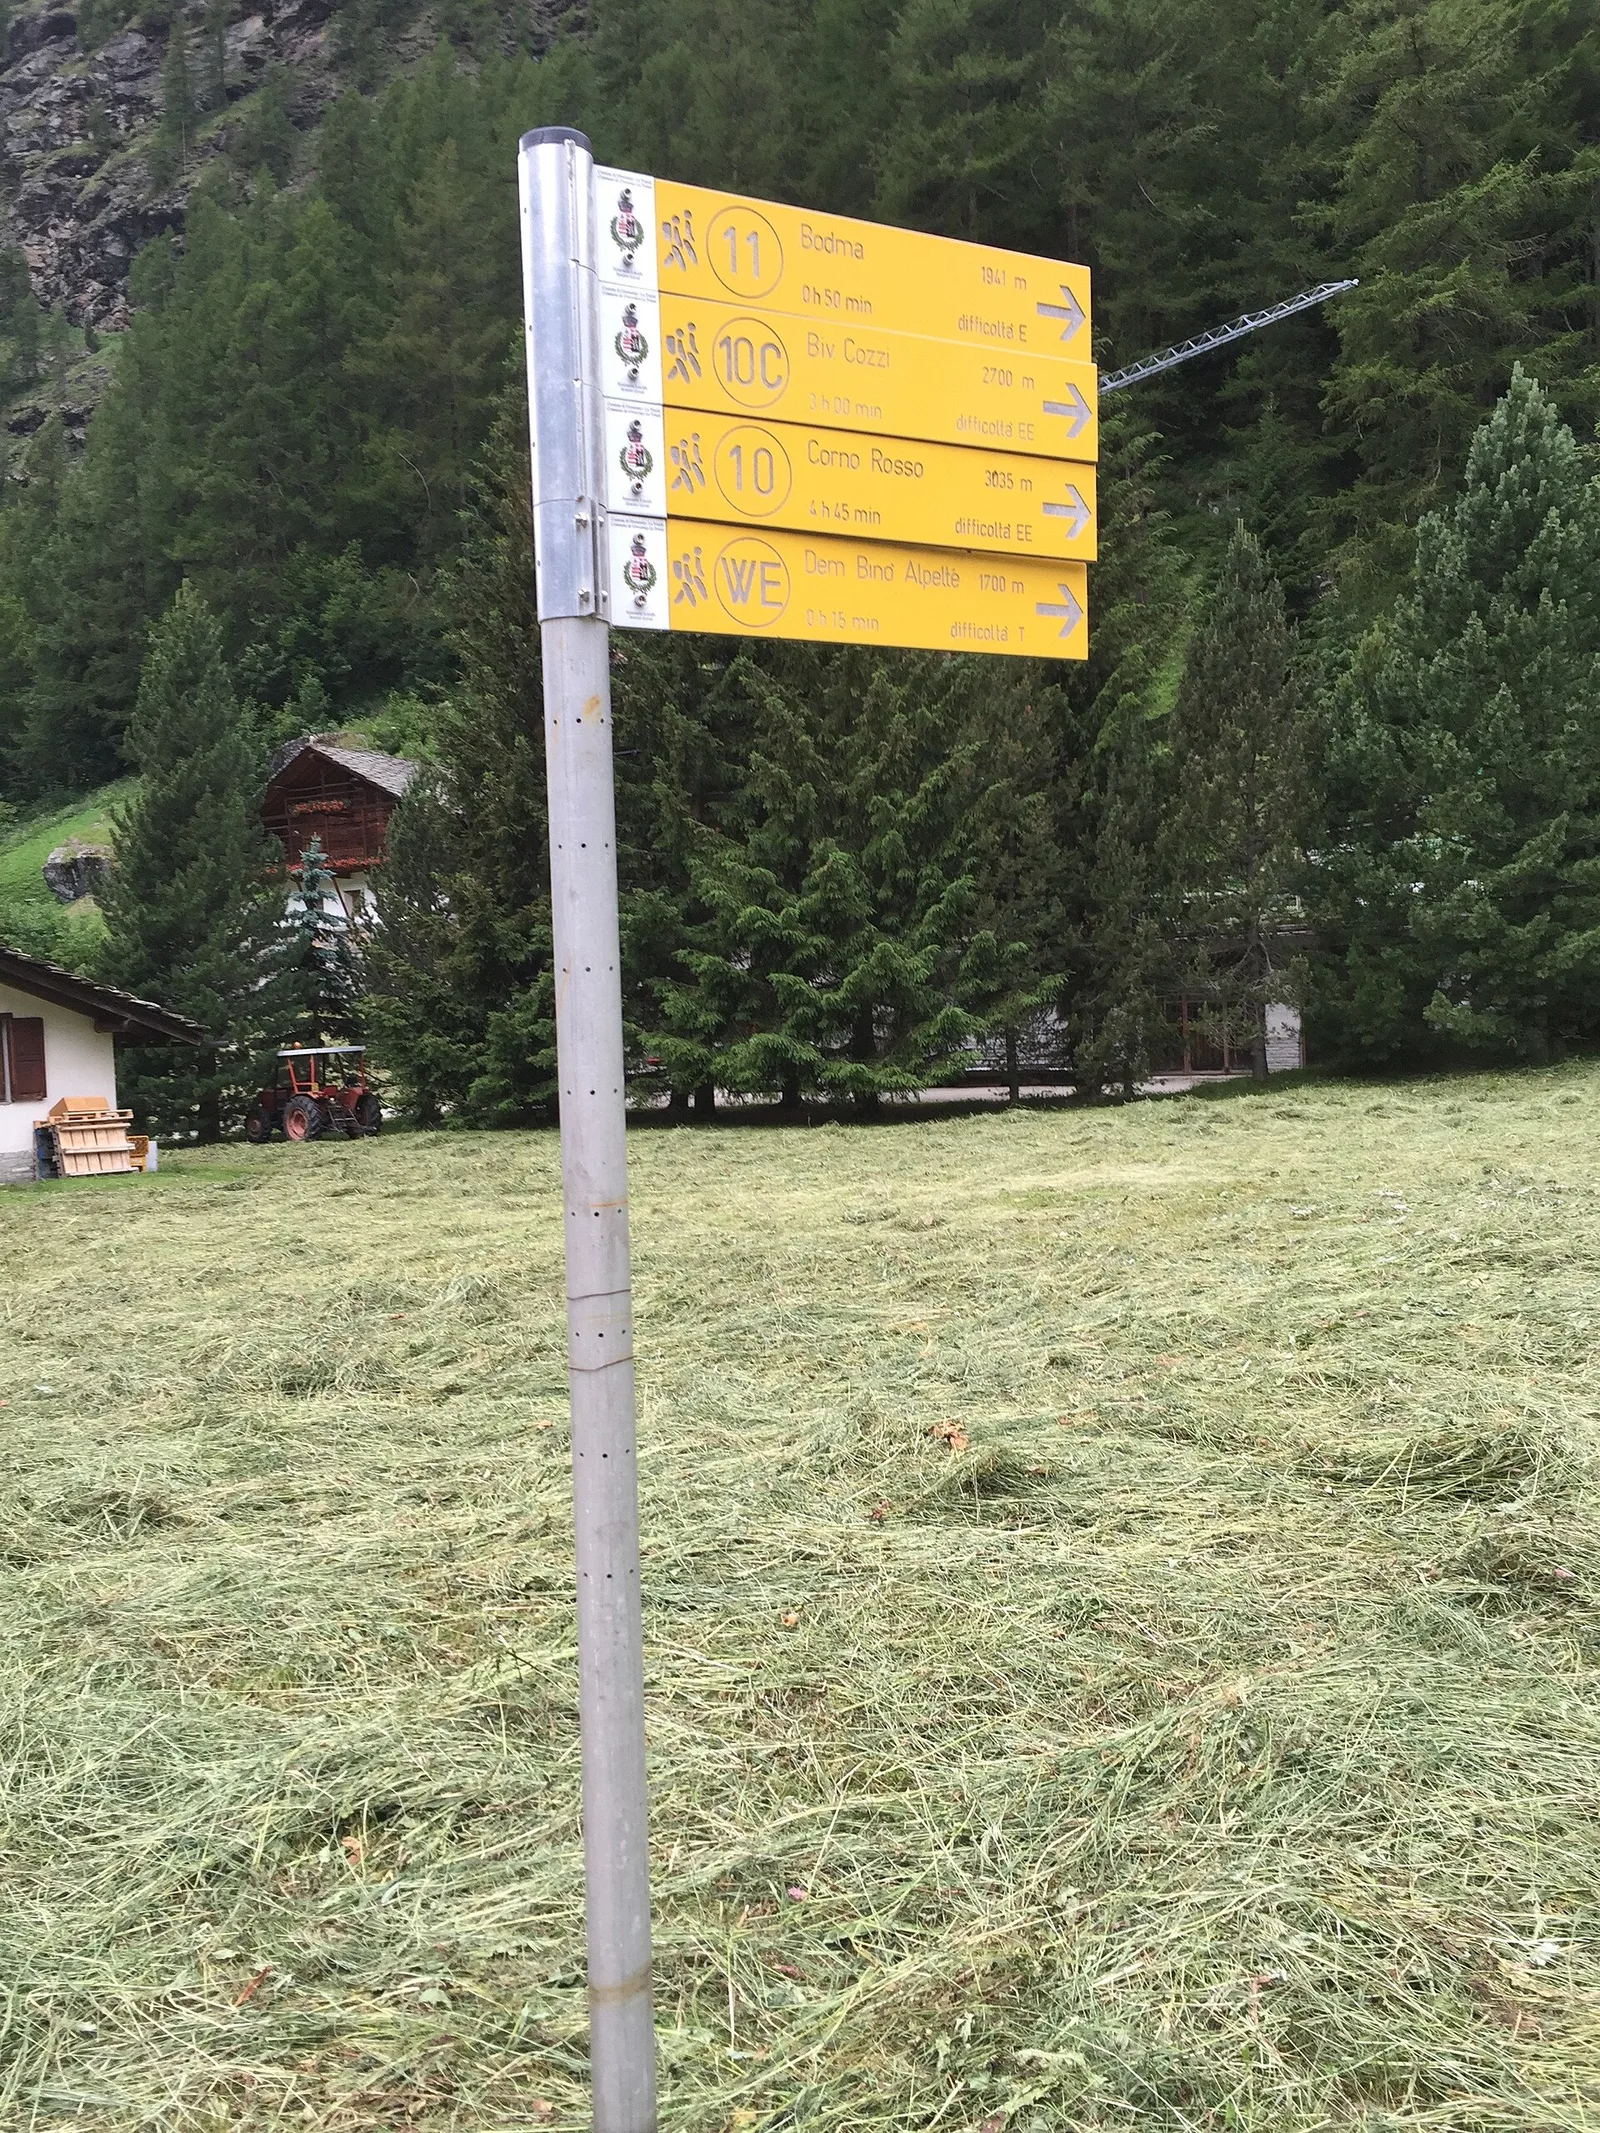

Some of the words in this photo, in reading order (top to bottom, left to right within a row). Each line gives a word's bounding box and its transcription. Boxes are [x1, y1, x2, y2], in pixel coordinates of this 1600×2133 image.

[724, 226, 760, 279] 11
[800, 222, 865, 261] Bodma
[981, 265, 1006, 286] 1941
[1014, 275, 1028, 291] m
[845, 294, 873, 315] min
[1018, 323, 1028, 343] E
[806, 331, 835, 360] Biv
[843, 337, 890, 369] Cozzi
[719, 335, 783, 390] 10C
[982, 366, 1013, 388] 2700
[1022, 375, 1035, 391] m
[855, 403, 882, 421] min
[1018, 422, 1035, 442] EE
[729, 444, 775, 495] 10
[807, 438, 861, 470] Corno
[871, 447, 925, 479] Rosso
[984, 469, 1015, 491] 3035
[1020, 476, 1034, 492] m
[854, 505, 881, 525] min
[1016, 524, 1034, 543] EE
[804, 549, 846, 577] Dem
[720, 556, 784, 609] WE
[979, 572, 1007, 593] 1700
[1011, 579, 1025, 595] m
[852, 616, 879, 632] min
[1018, 626, 1026, 642] T
